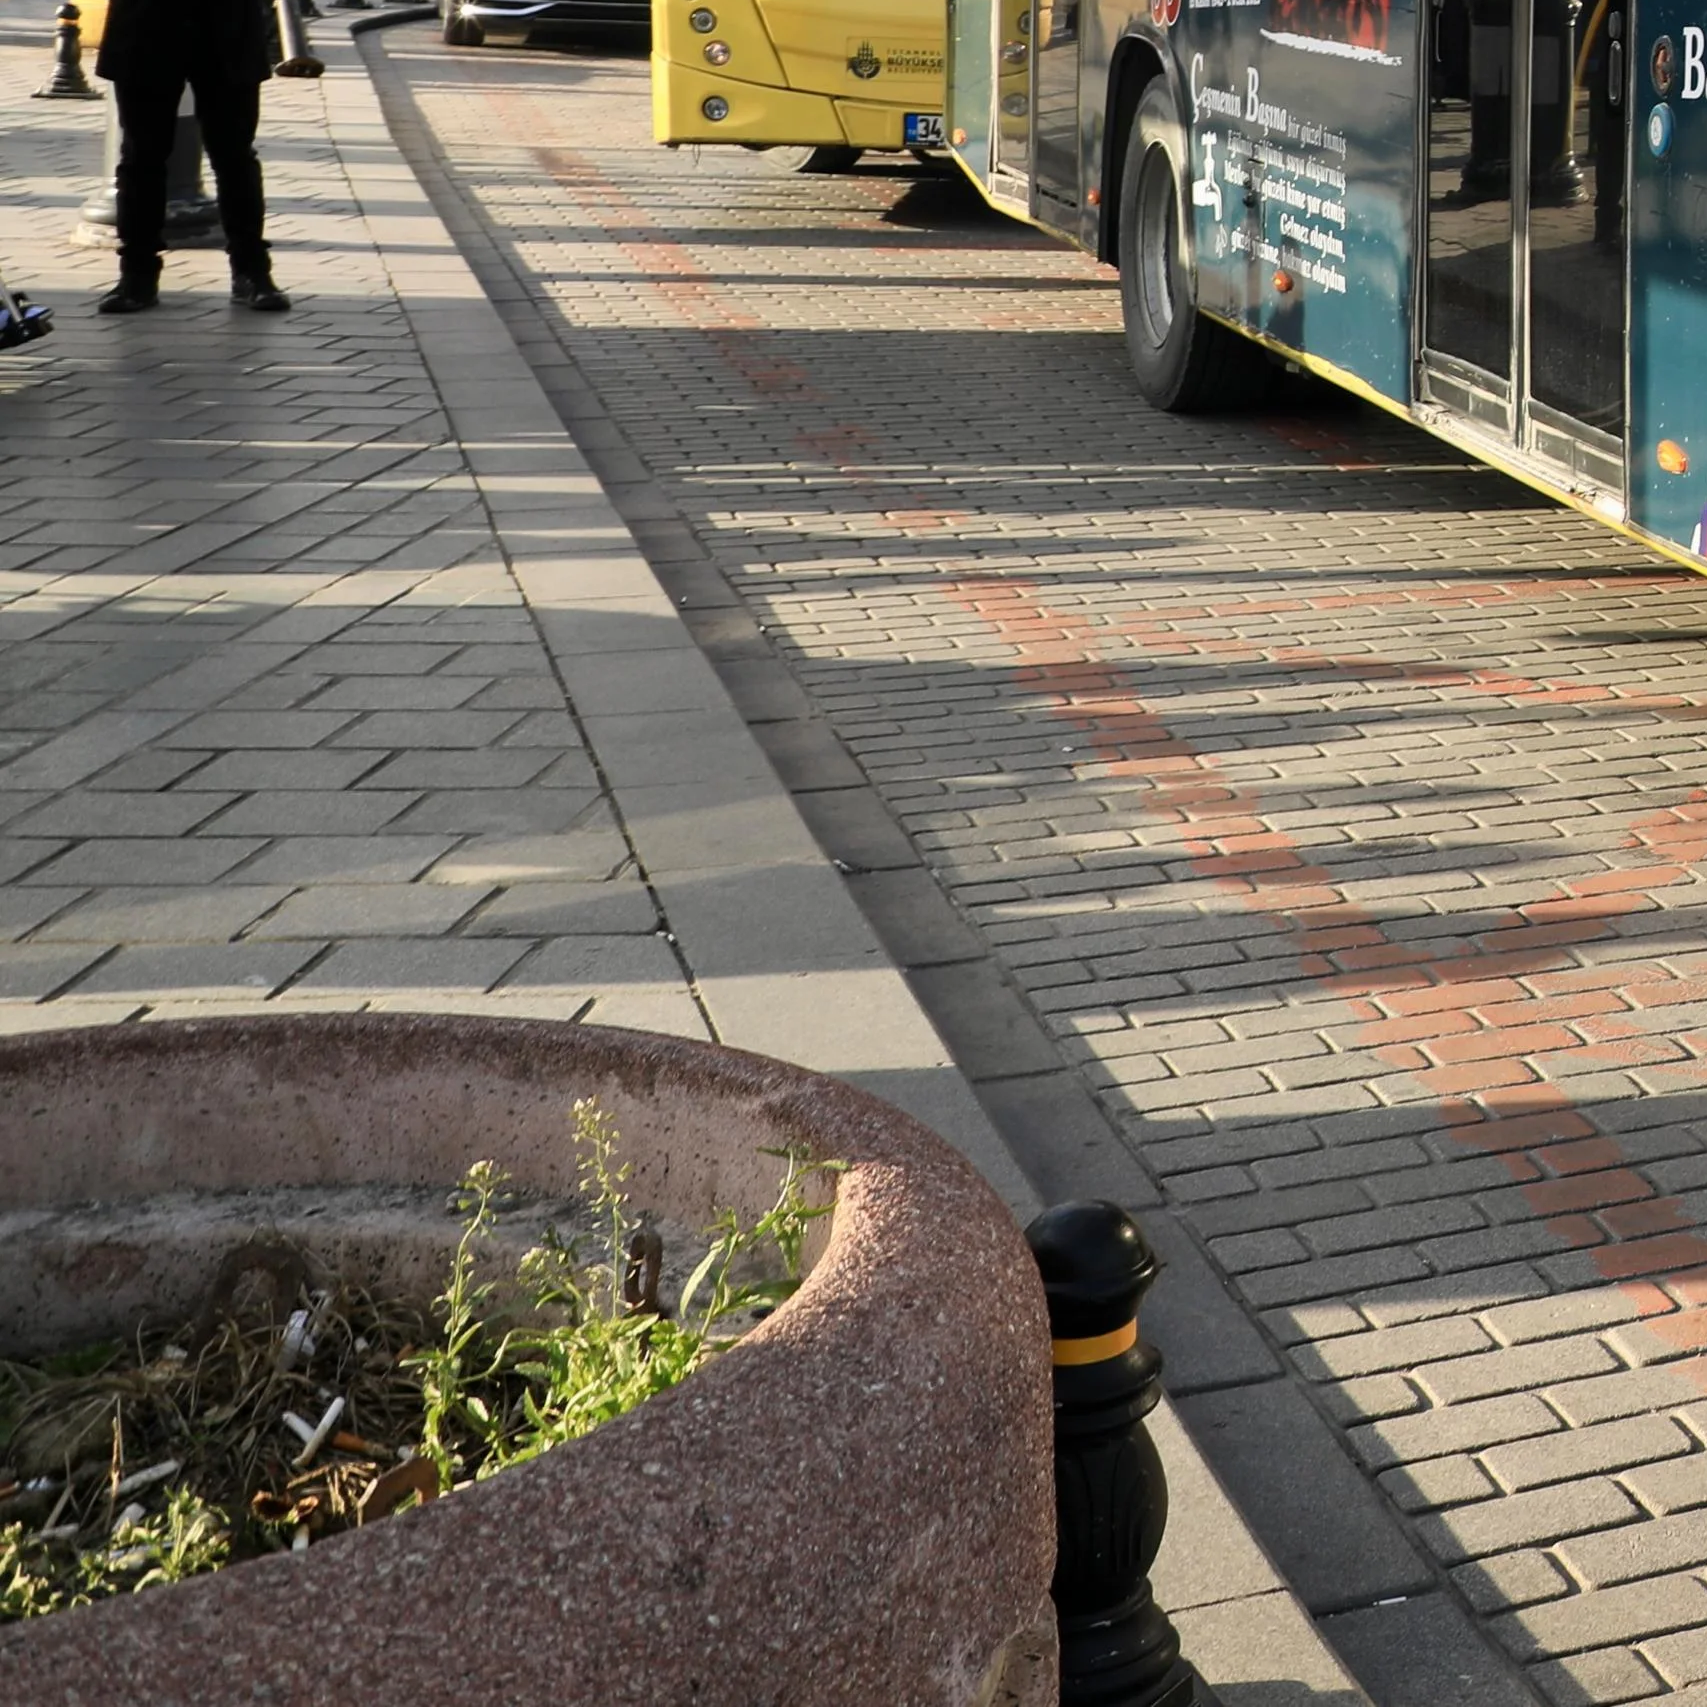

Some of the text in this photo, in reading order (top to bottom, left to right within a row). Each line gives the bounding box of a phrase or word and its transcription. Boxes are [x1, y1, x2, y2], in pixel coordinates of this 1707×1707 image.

[1190, 52, 1241, 124] Çeşmenin
[1245, 66, 1287, 137] Başına
[918, 117, 942, 139] 34
